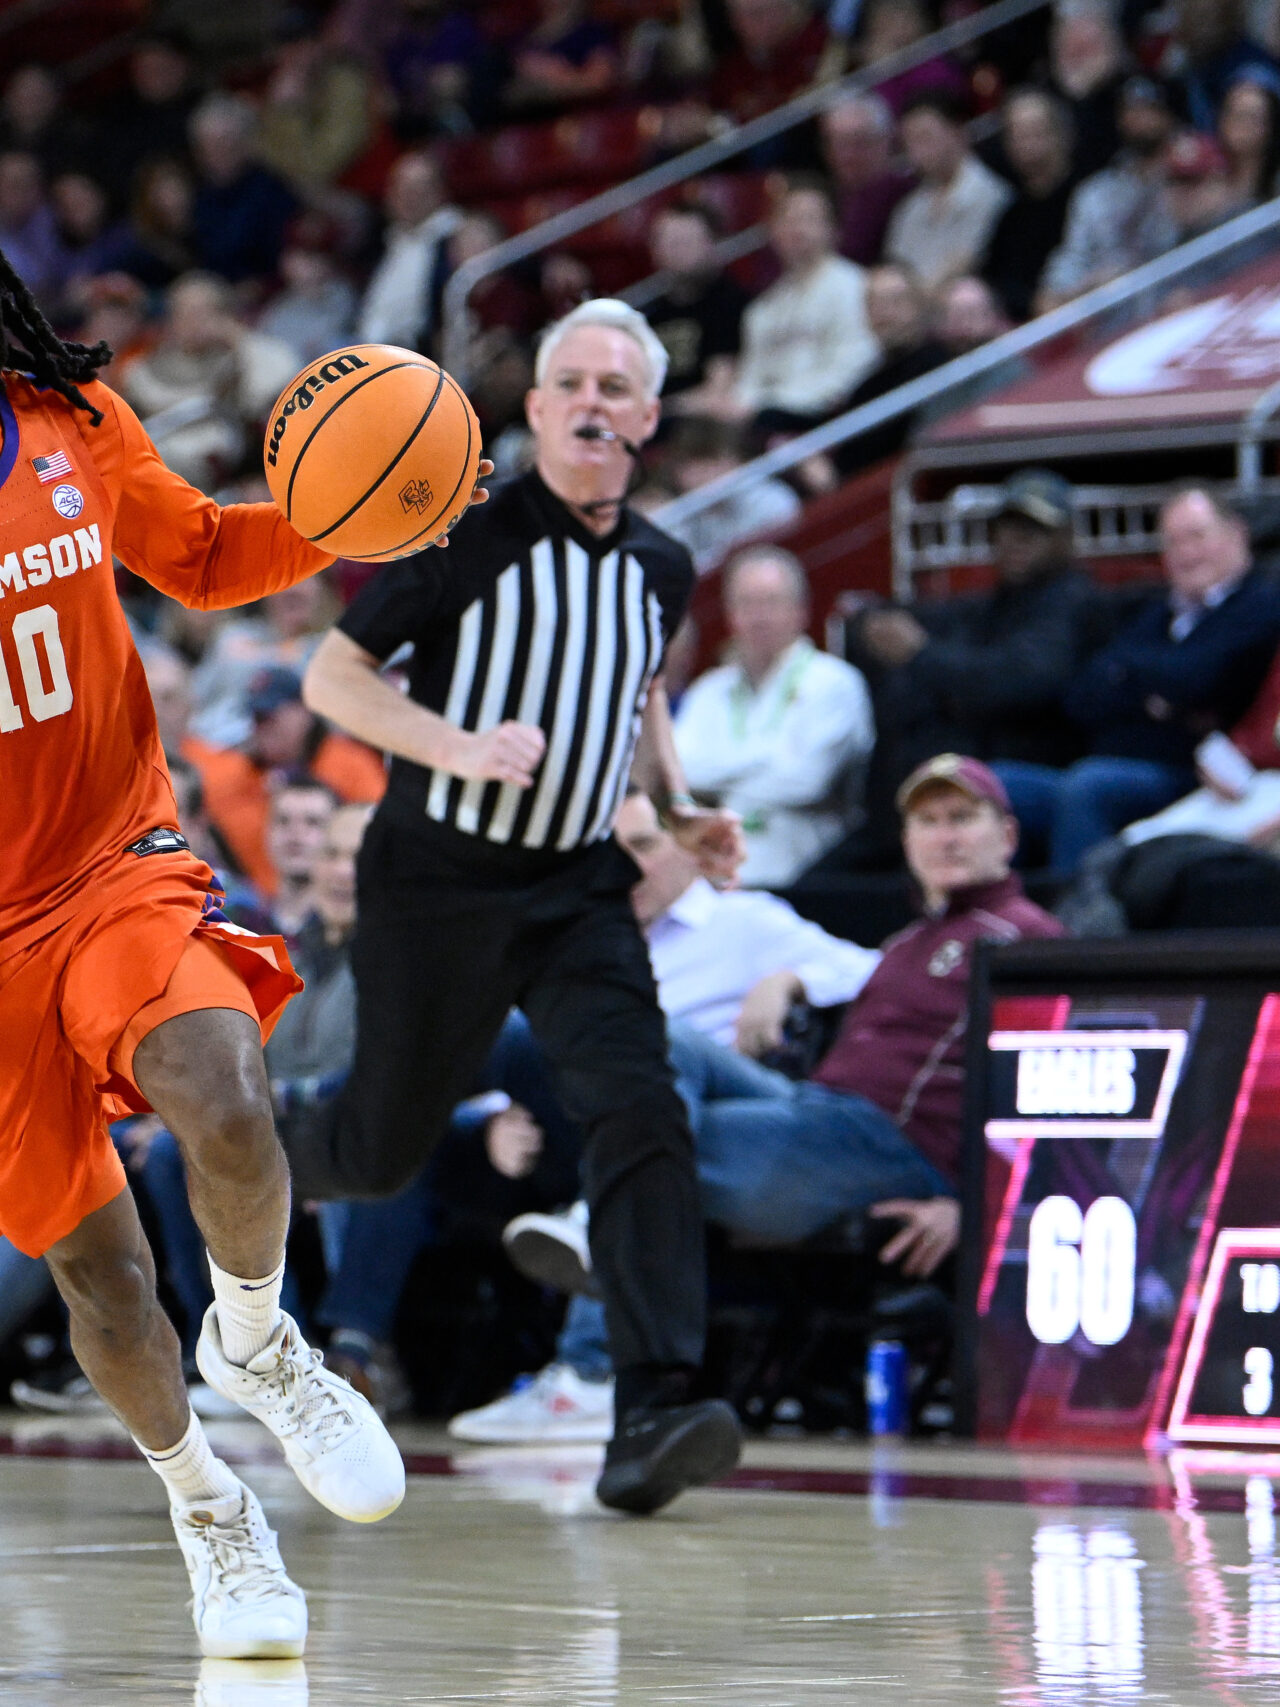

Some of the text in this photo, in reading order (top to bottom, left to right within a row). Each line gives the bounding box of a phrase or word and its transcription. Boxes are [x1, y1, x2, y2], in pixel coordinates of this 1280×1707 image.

[267, 353, 369, 467] Wilson
[59, 492, 79, 505] ACC
[1026, 1195, 1137, 1345] 60
[1243, 1346, 1274, 1416] 3
